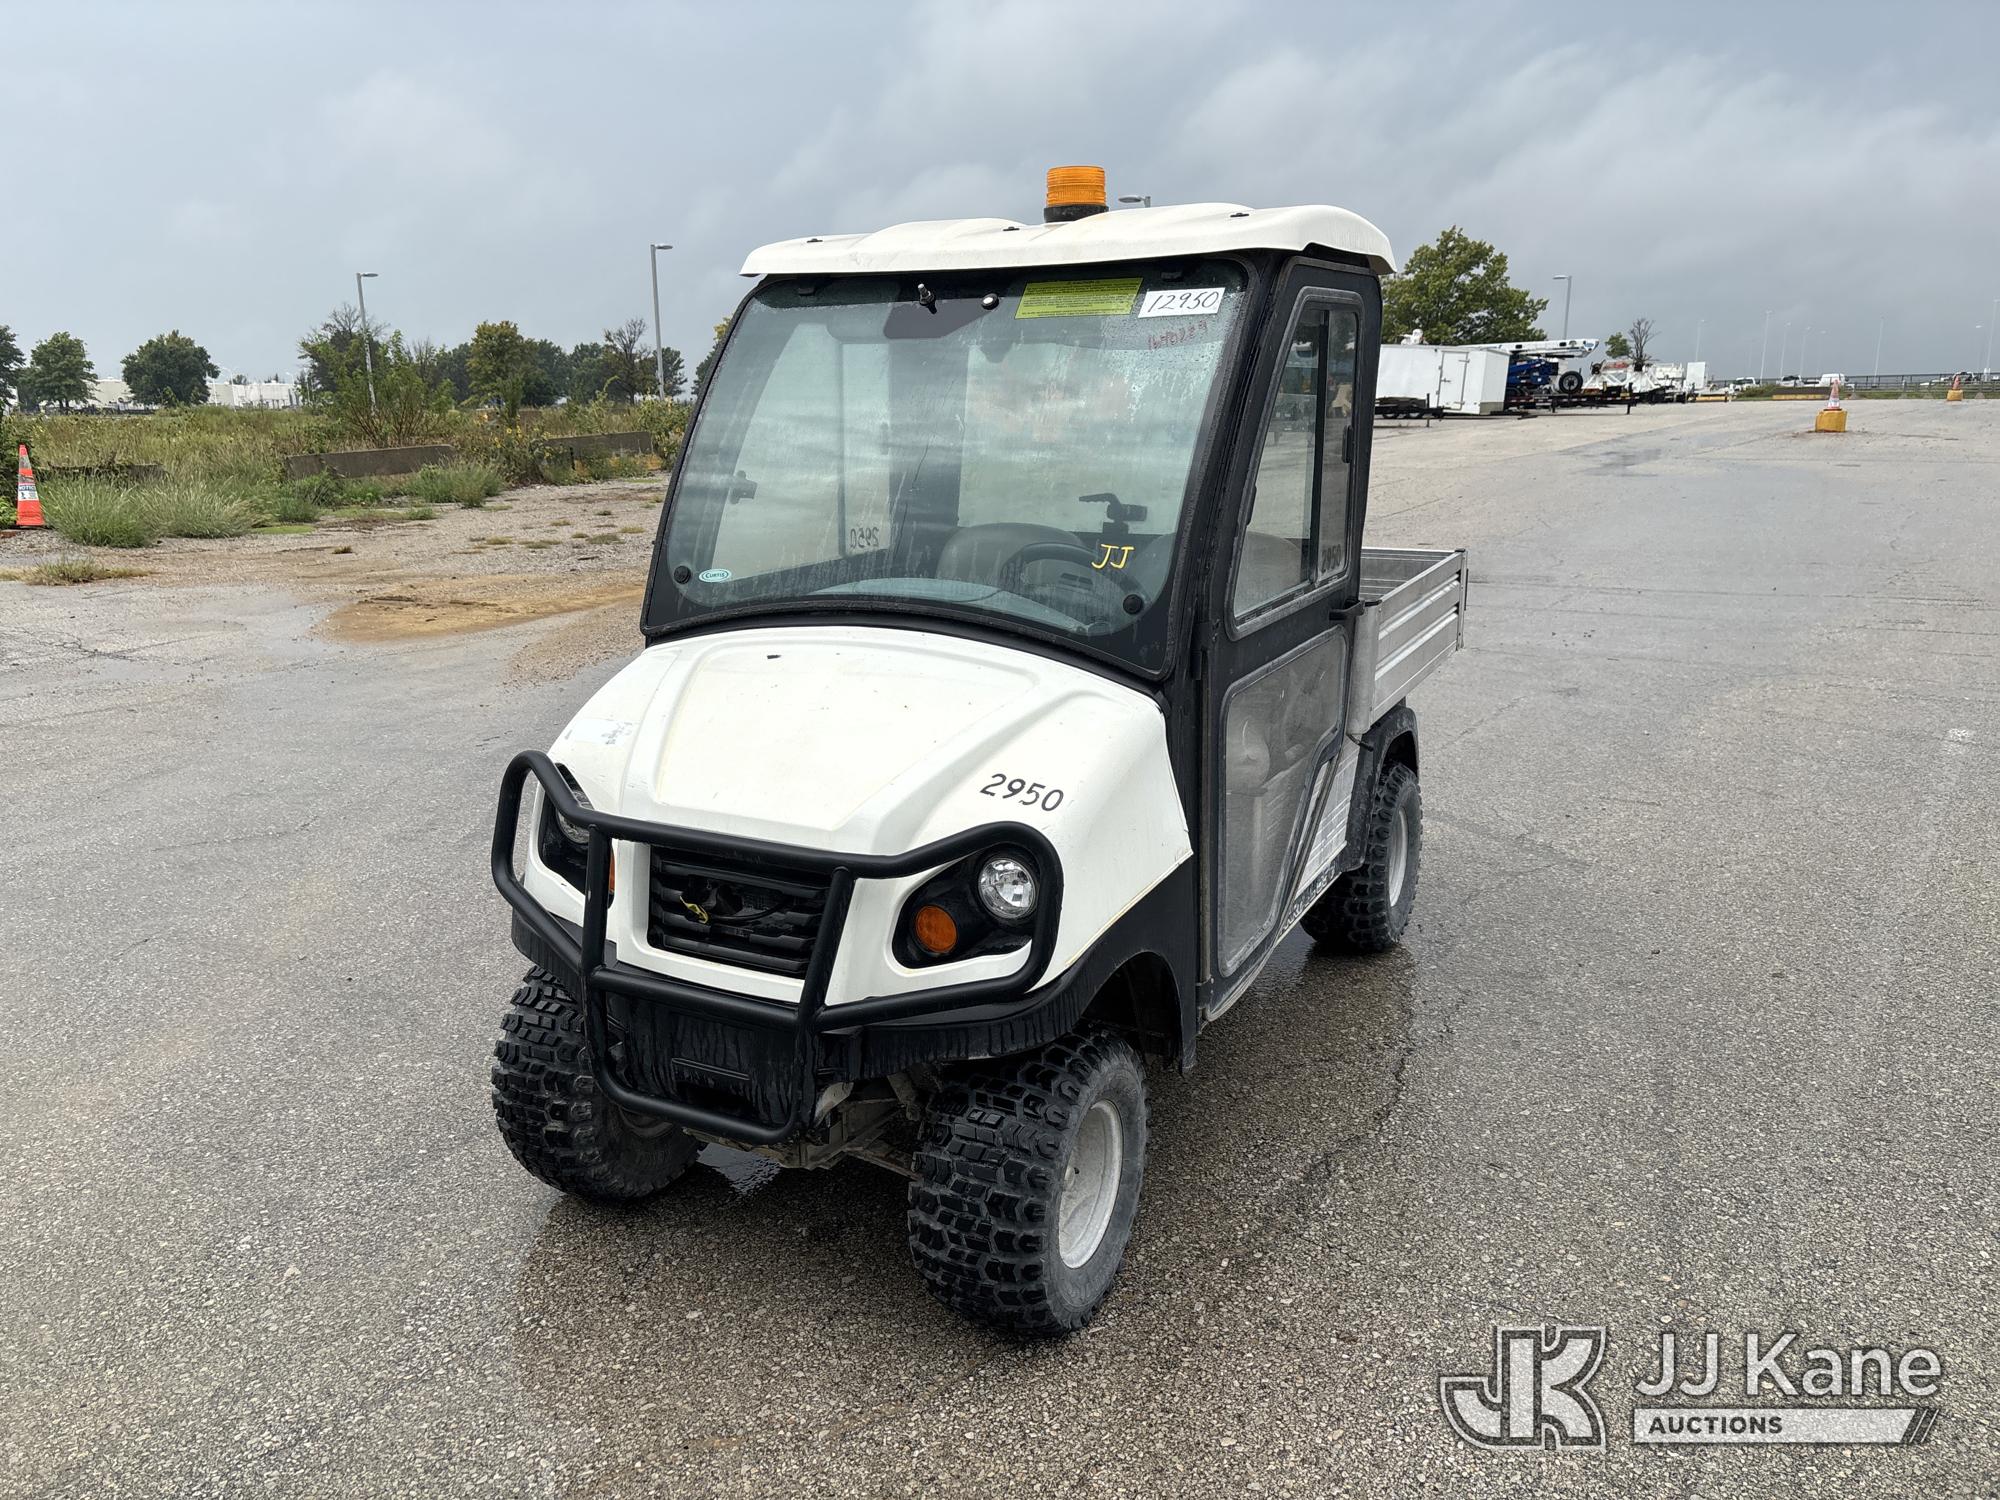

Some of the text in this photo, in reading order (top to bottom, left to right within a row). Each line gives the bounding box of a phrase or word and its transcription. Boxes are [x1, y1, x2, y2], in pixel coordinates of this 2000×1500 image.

[1148, 291, 1219, 313] 12950
[1091, 543, 1135, 569] JJ
[979, 773, 1064, 812] 2950
